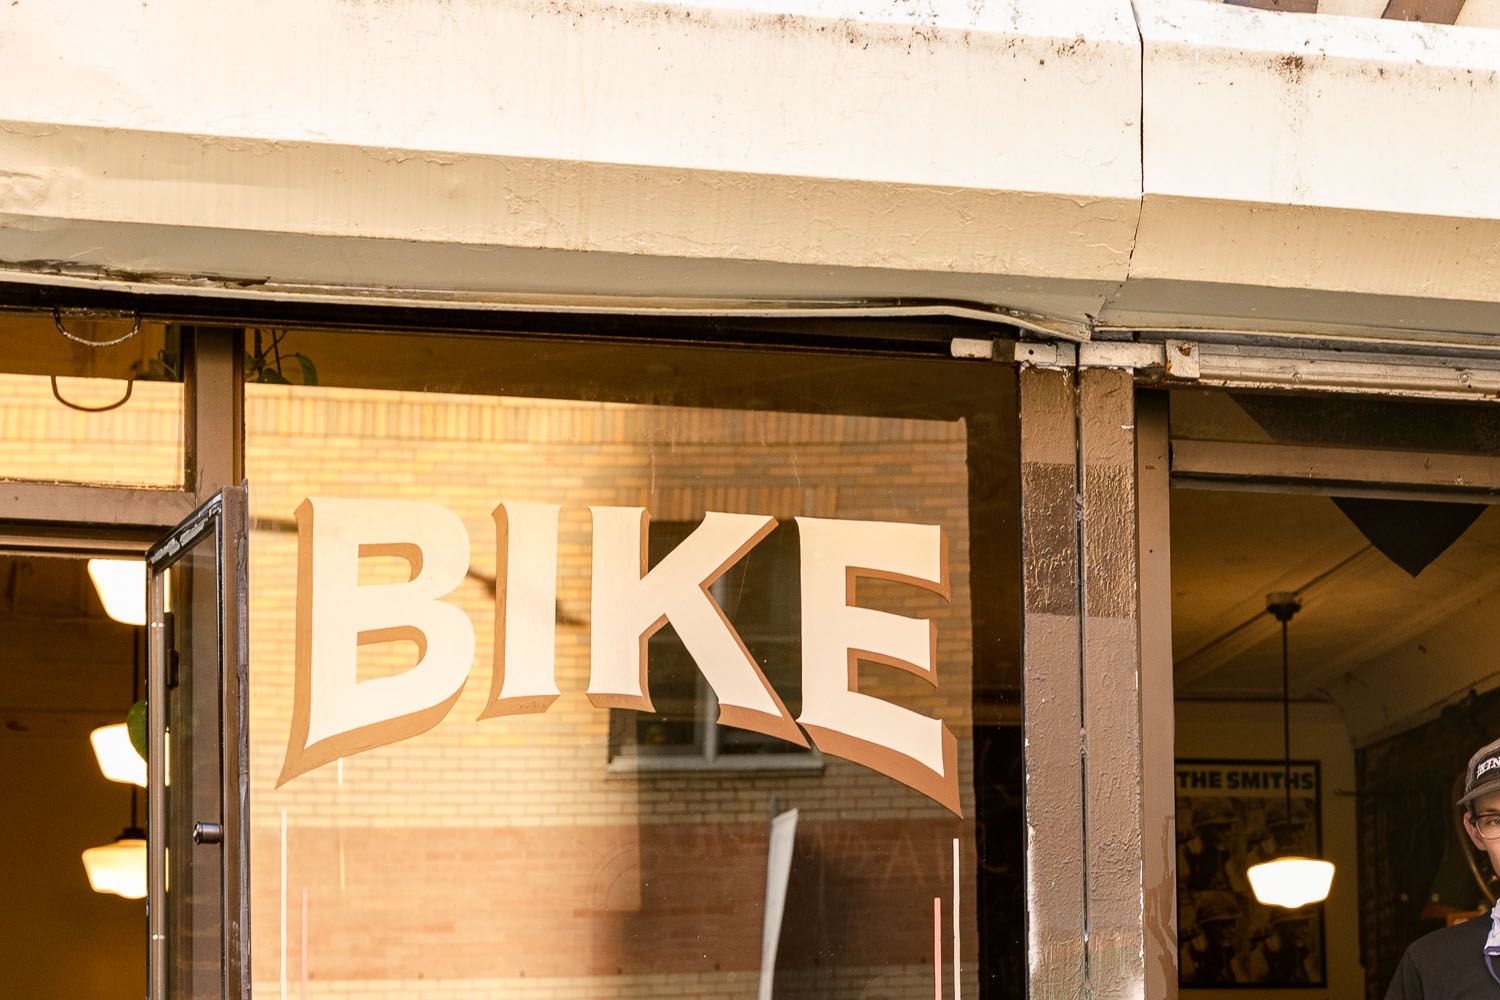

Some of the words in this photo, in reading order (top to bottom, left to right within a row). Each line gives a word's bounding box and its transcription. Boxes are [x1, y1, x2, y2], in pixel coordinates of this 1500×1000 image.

[276, 497, 962, 820] BIKE
[1179, 770, 1221, 789] THE
[1227, 771, 1314, 790] SMITHS
